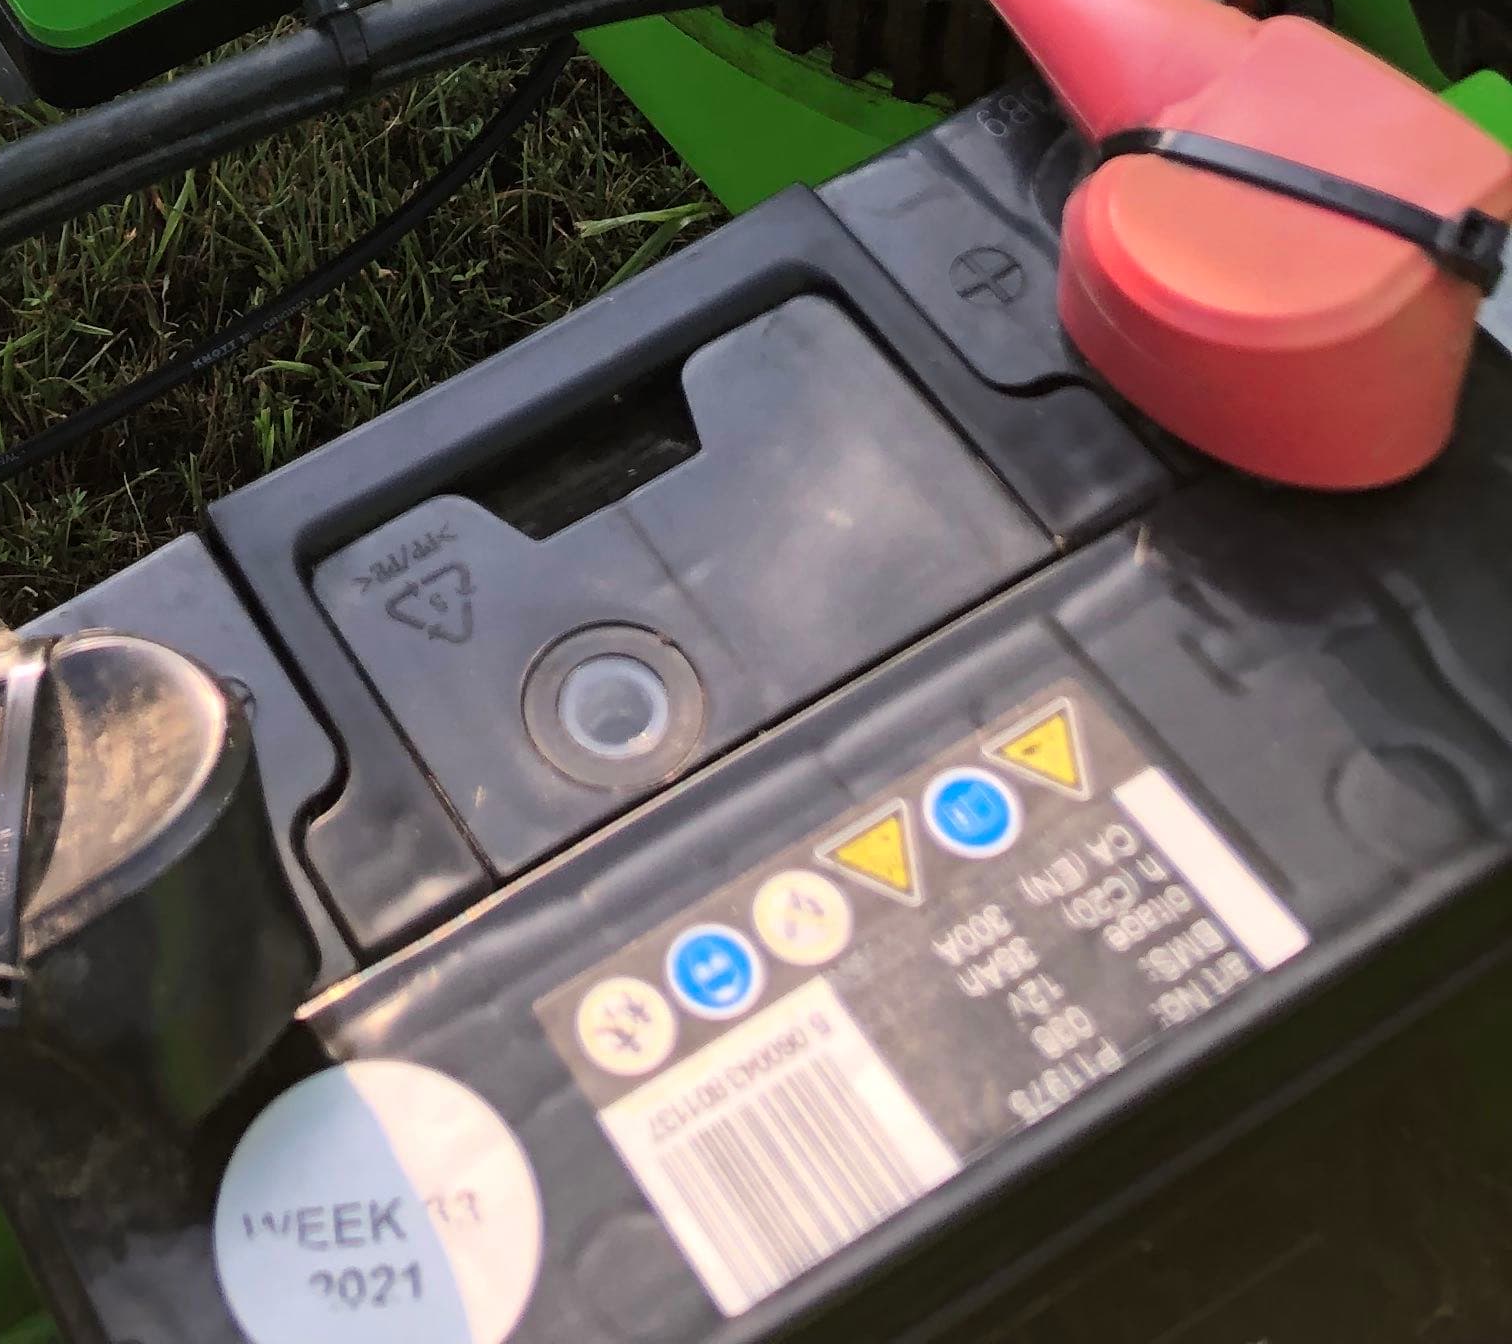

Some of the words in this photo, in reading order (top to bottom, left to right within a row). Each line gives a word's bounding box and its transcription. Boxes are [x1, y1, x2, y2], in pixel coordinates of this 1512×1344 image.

[1102, 884, 1194, 952] oltage
[1200, 951, 1250, 994] art
[241, 1195, 408, 1252] WEEK
[309, 1260, 423, 1310] 2021
